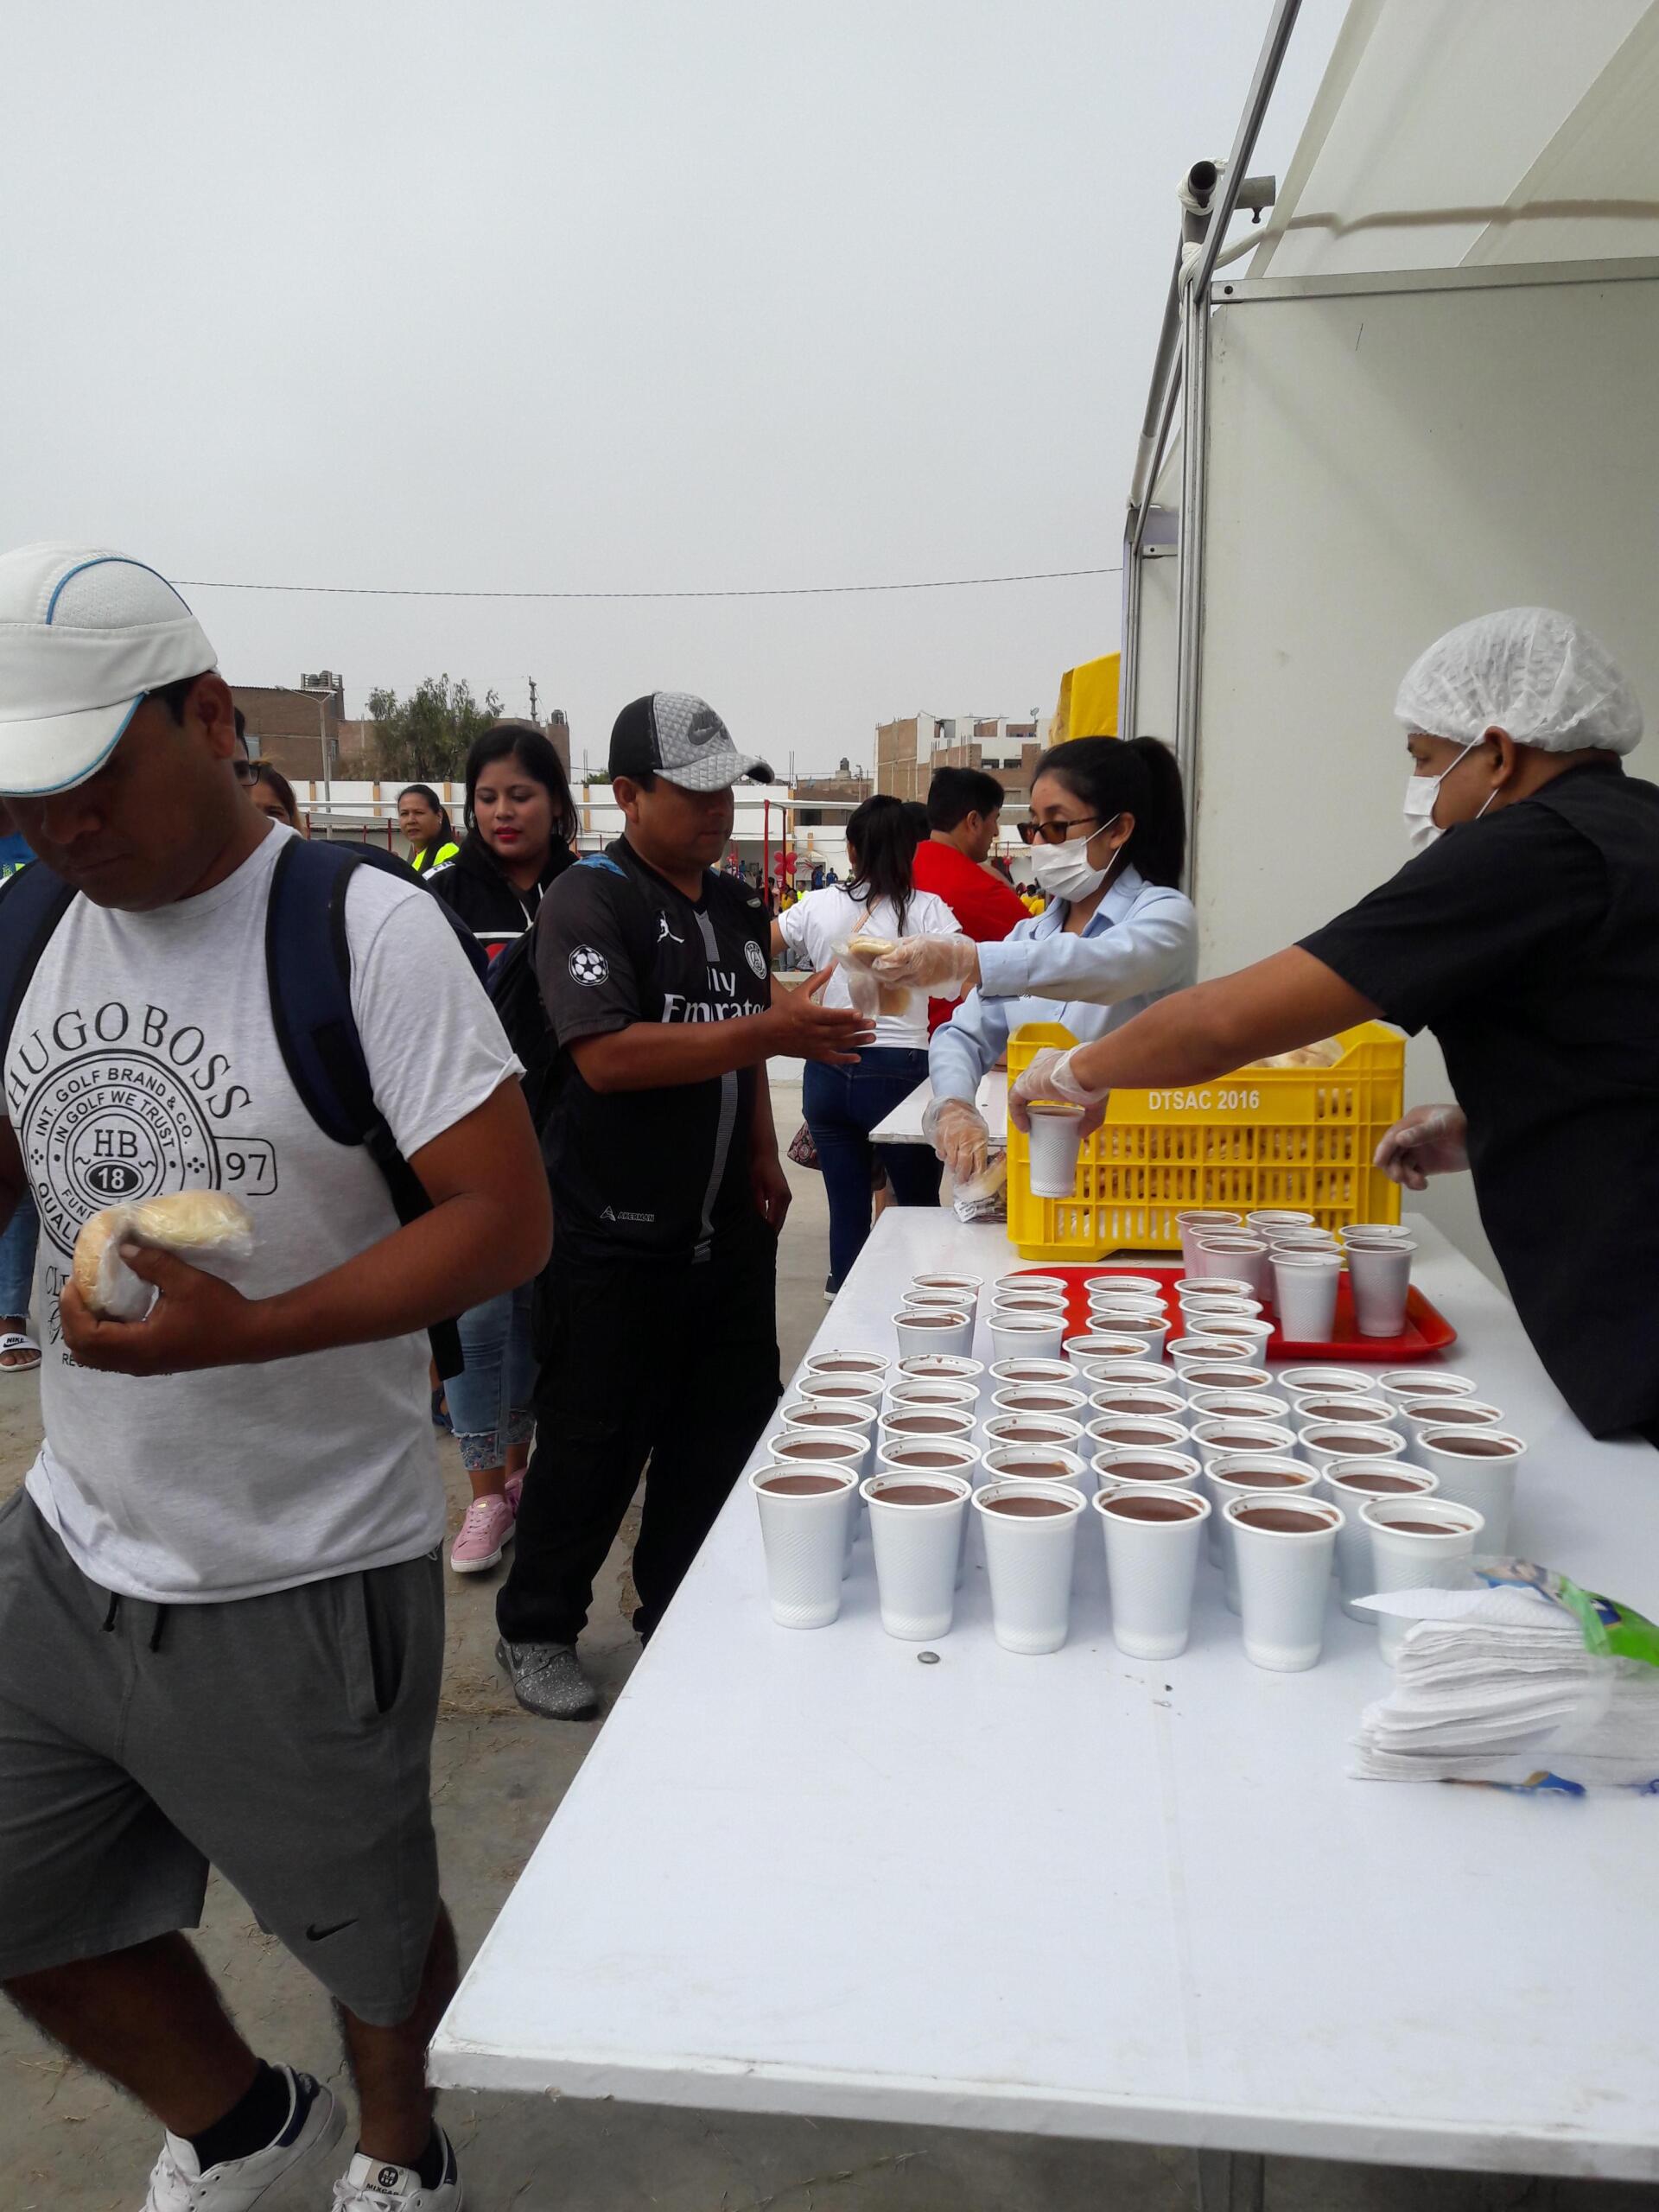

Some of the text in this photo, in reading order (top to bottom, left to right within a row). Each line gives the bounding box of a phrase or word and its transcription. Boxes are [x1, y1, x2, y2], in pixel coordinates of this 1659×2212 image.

[7, 1001, 253, 1119] HUGO BOSS
[35, 1067, 192, 1144] INT. GOLF BRAND & CO.
[1148, 1090, 1261, 1110] DTSAC 2016
[54, 1090, 175, 1147] IN GOLF WE TRUST
[92, 1128, 138, 1159] HB
[97, 1166, 125, 1191] 18
[226, 1152, 268, 1182] 97
